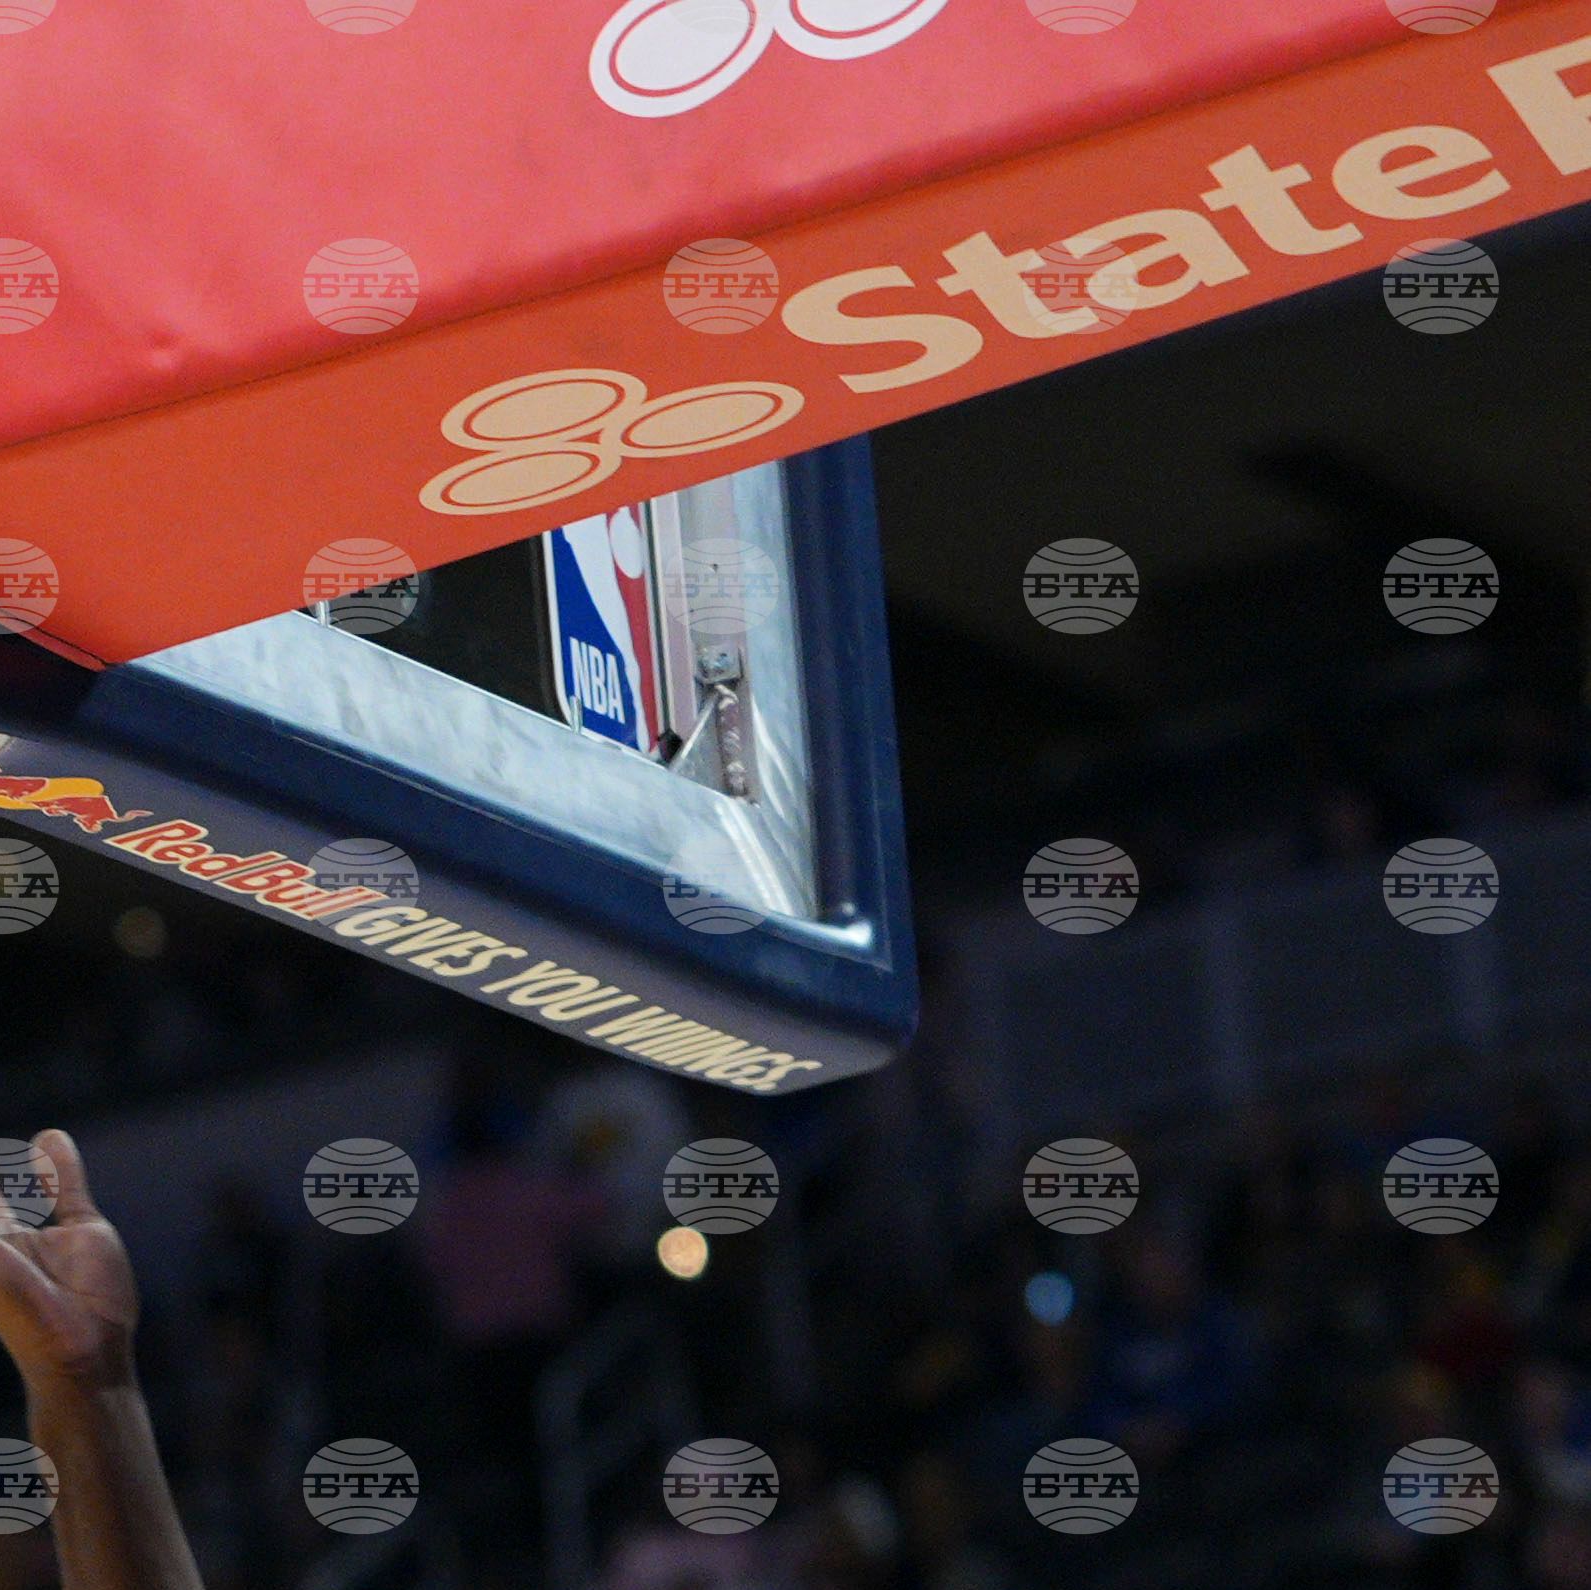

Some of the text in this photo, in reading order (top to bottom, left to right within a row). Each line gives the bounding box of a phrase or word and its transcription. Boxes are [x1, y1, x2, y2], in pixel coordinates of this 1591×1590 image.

[782, 126, 1511, 393] State
[569, 636, 626, 725] NBA
[334, 906, 528, 978] GIVES
[480, 960, 641, 1022] YOU
